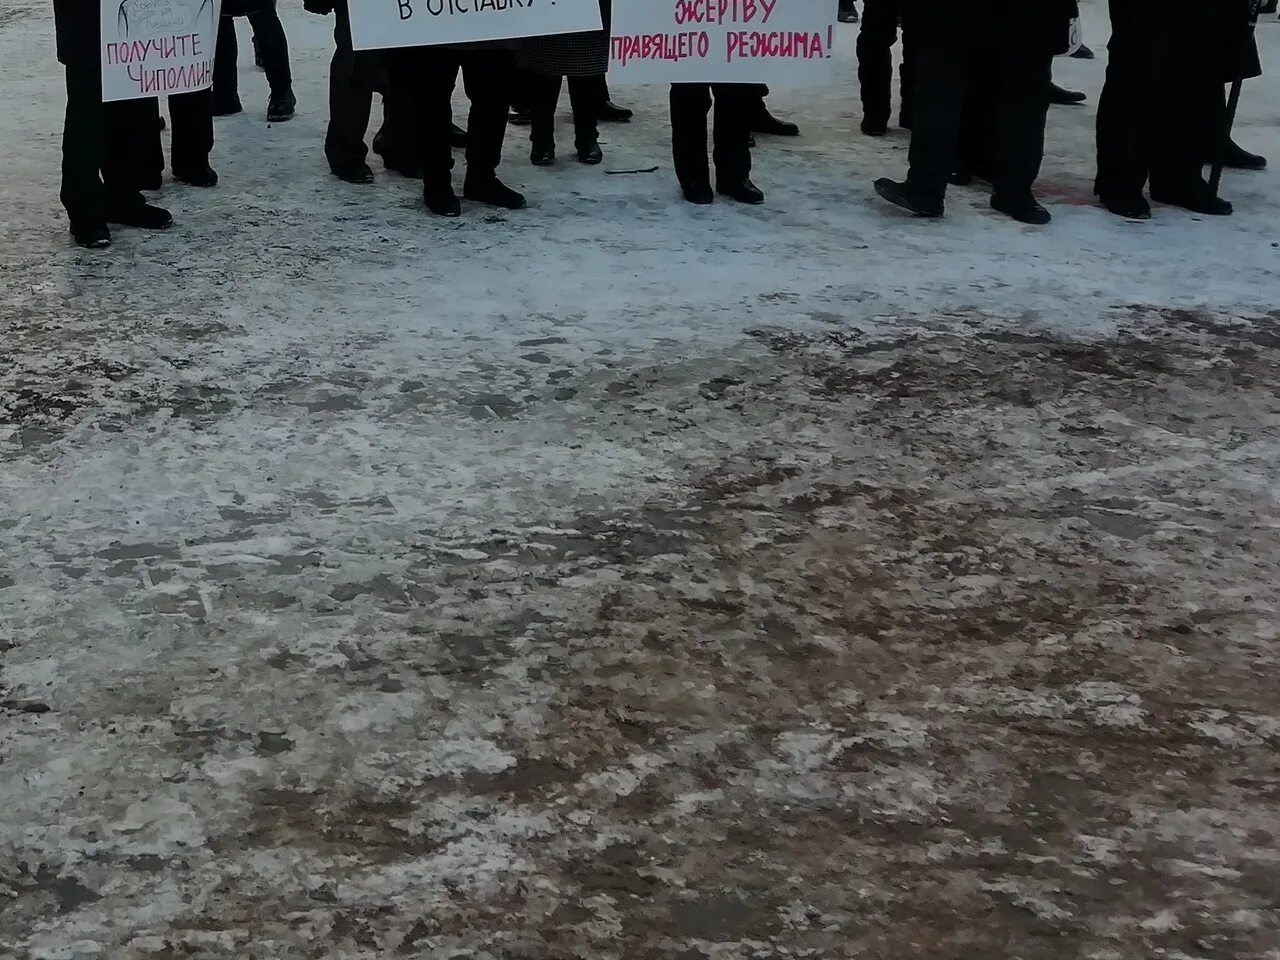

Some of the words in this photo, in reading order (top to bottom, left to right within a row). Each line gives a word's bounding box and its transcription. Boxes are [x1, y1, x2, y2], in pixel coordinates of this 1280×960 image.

[107, 33, 202, 65] ПОЛУЧИТЕ
[611, 30, 710, 66] ПРАВЯЩЕГО
[726, 24, 833, 63] РЕЖИМА!
